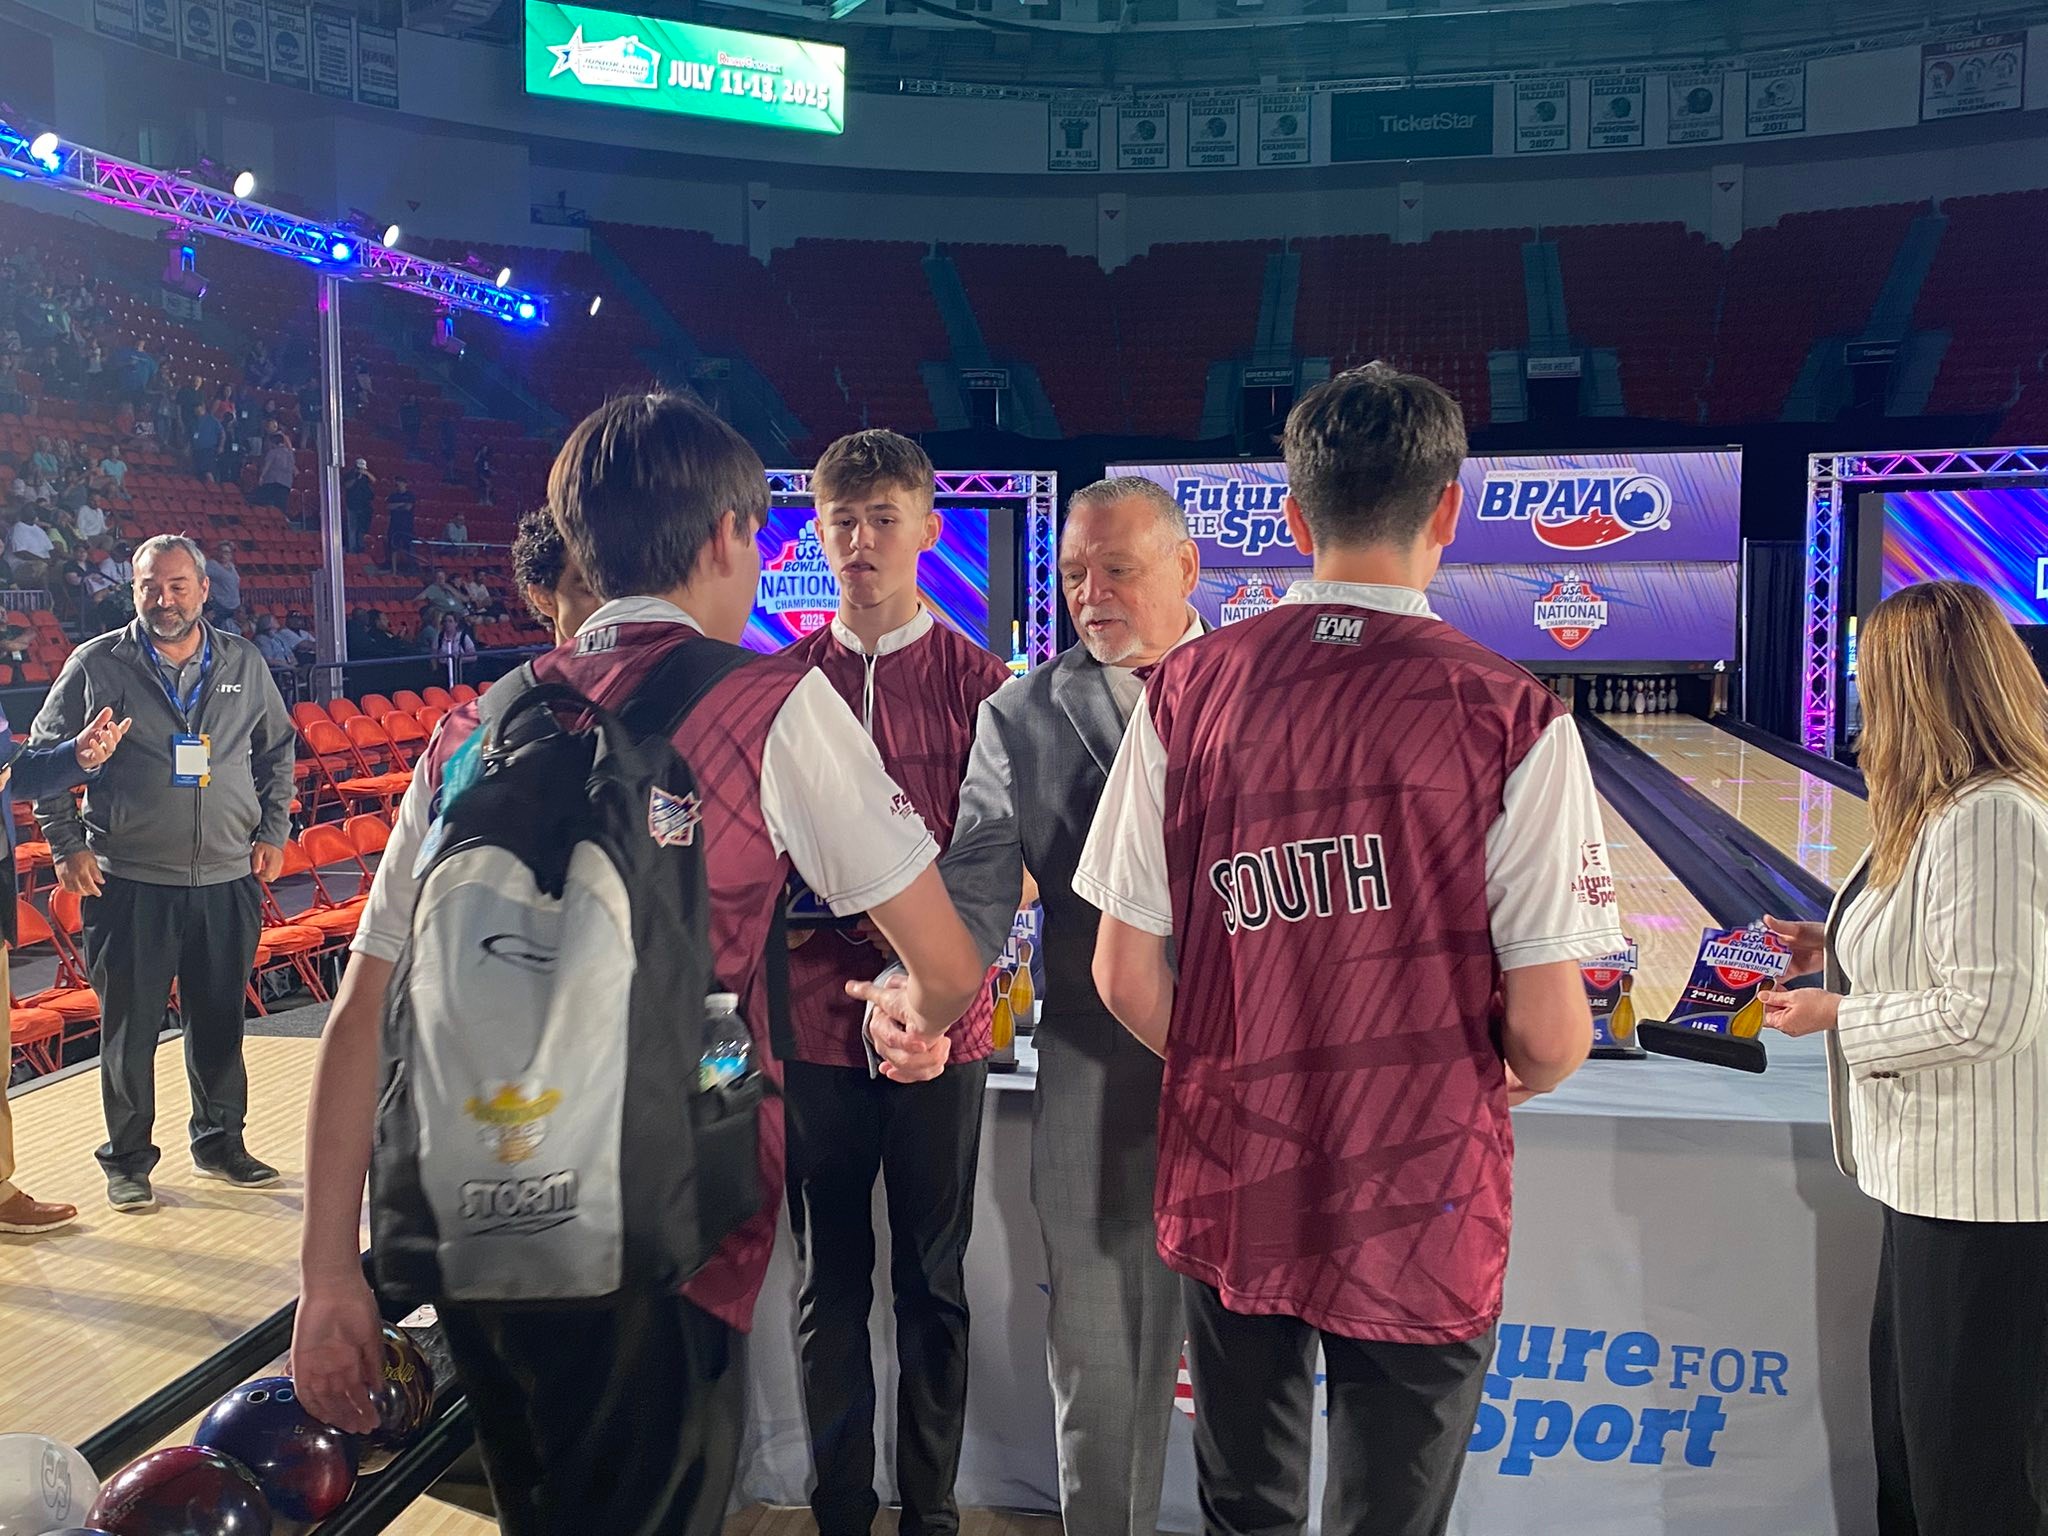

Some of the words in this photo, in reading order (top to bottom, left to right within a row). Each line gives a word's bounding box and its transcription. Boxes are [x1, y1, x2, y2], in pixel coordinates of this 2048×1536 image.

[1946, 38, 1982, 52] HOME
[1985, 35, 2003, 46] OF
[668, 59, 715, 91] JULY
[719, 69, 778, 104] 11-13,
[782, 79, 830, 110] 2025
[1594, 85, 1641, 96] BLIZZARD
[1379, 112, 1478, 132] TicketStar
[1176, 479, 1289, 511] Futur
[1480, 479, 1614, 518] BPAA
[1186, 516, 1217, 535] HE
[1220, 509, 1294, 553] Spo
[783, 561, 829, 572] BOWLIN
[761, 575, 840, 600] NATION
[1244, 588, 1265, 598] USA
[1561, 586, 1583, 595] USA
[1552, 595, 1590, 603] BOWLING
[1537, 604, 1605, 621] NATIONAL
[800, 613, 826, 626] 2025
[1546, 619, 1596, 627] CHAMPIONSHIPS
[1713, 659, 1726, 672] 4
[1208, 834, 1392, 936] SOUTH
[1741, 932, 1765, 943] USA
[1729, 940, 1772, 952] BOWLING
[1706, 944, 1783, 970] NATIONAL
[1714, 959, 1770, 974] CHAMPIONSHIPS
[1729, 970, 1750, 979] 2025
[1589, 998, 1608, 1007] LACE
[1706, 993, 1736, 1005] PLACE
[1496, 1323, 1660, 1387] ure
[1669, 1344, 1789, 1396] FOR
